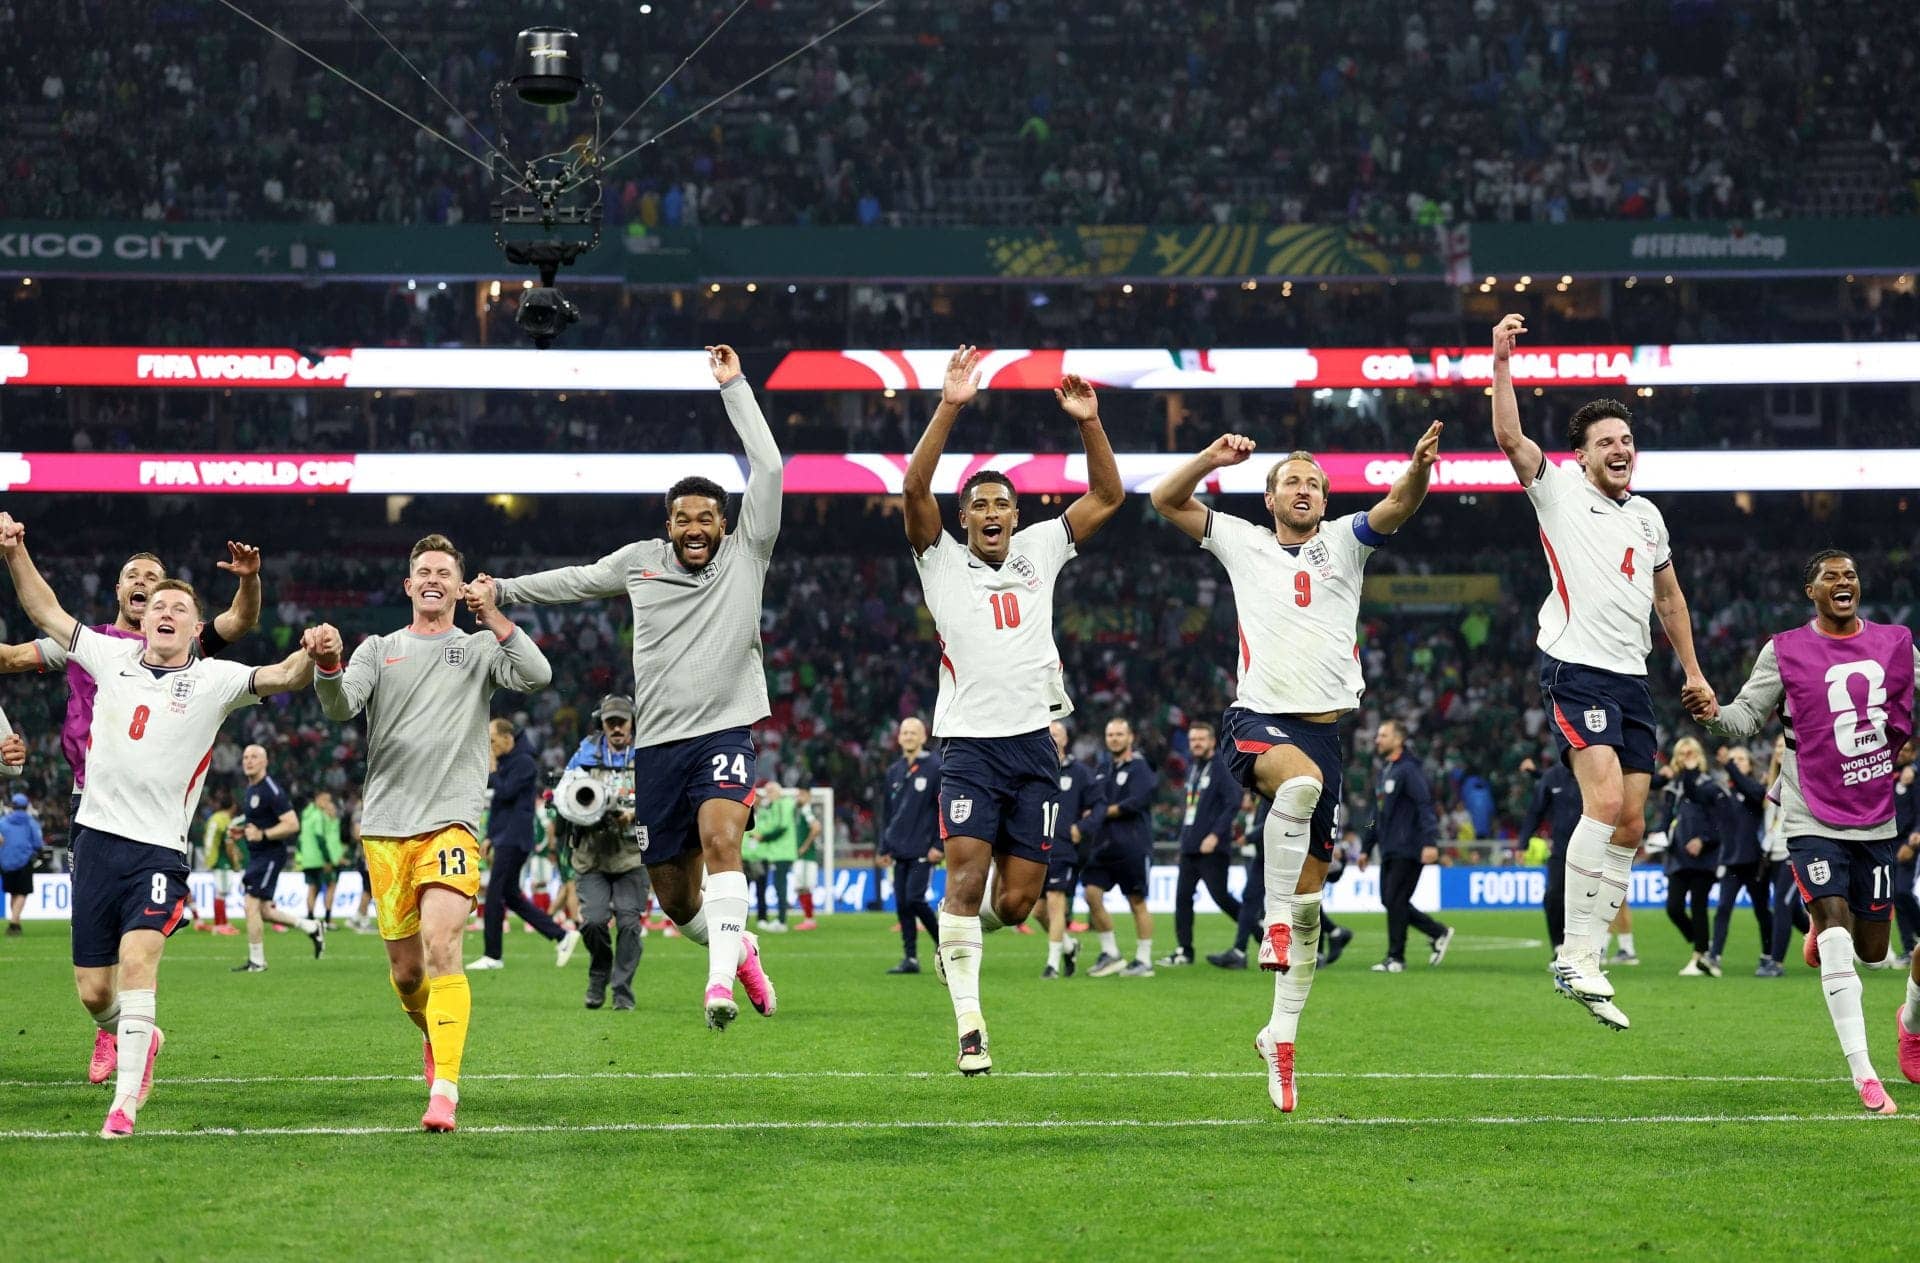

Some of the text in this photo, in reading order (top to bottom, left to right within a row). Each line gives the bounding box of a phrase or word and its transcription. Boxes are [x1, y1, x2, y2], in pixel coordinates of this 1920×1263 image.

[114, 234, 227, 260] CITY
[137, 354, 352, 380] FIFA WORLD CUP
[139, 461, 354, 486] FIFA WORLD CUP
[1620, 547, 1635, 582] 4
[1294, 570, 1312, 608] 9
[989, 592, 1021, 630] 10
[128, 704, 151, 741] 8
[1854, 733, 1879, 748] FIFA
[711, 753, 748, 784] 24
[1840, 748, 1892, 772] WORLD CUP
[1842, 760, 1893, 786] 2026
[438, 847, 466, 876] 13
[151, 872, 168, 904] 8
[1469, 871, 1546, 905] FOOTB
[1872, 864, 1891, 899] 11
[720, 922, 741, 933] ENG
